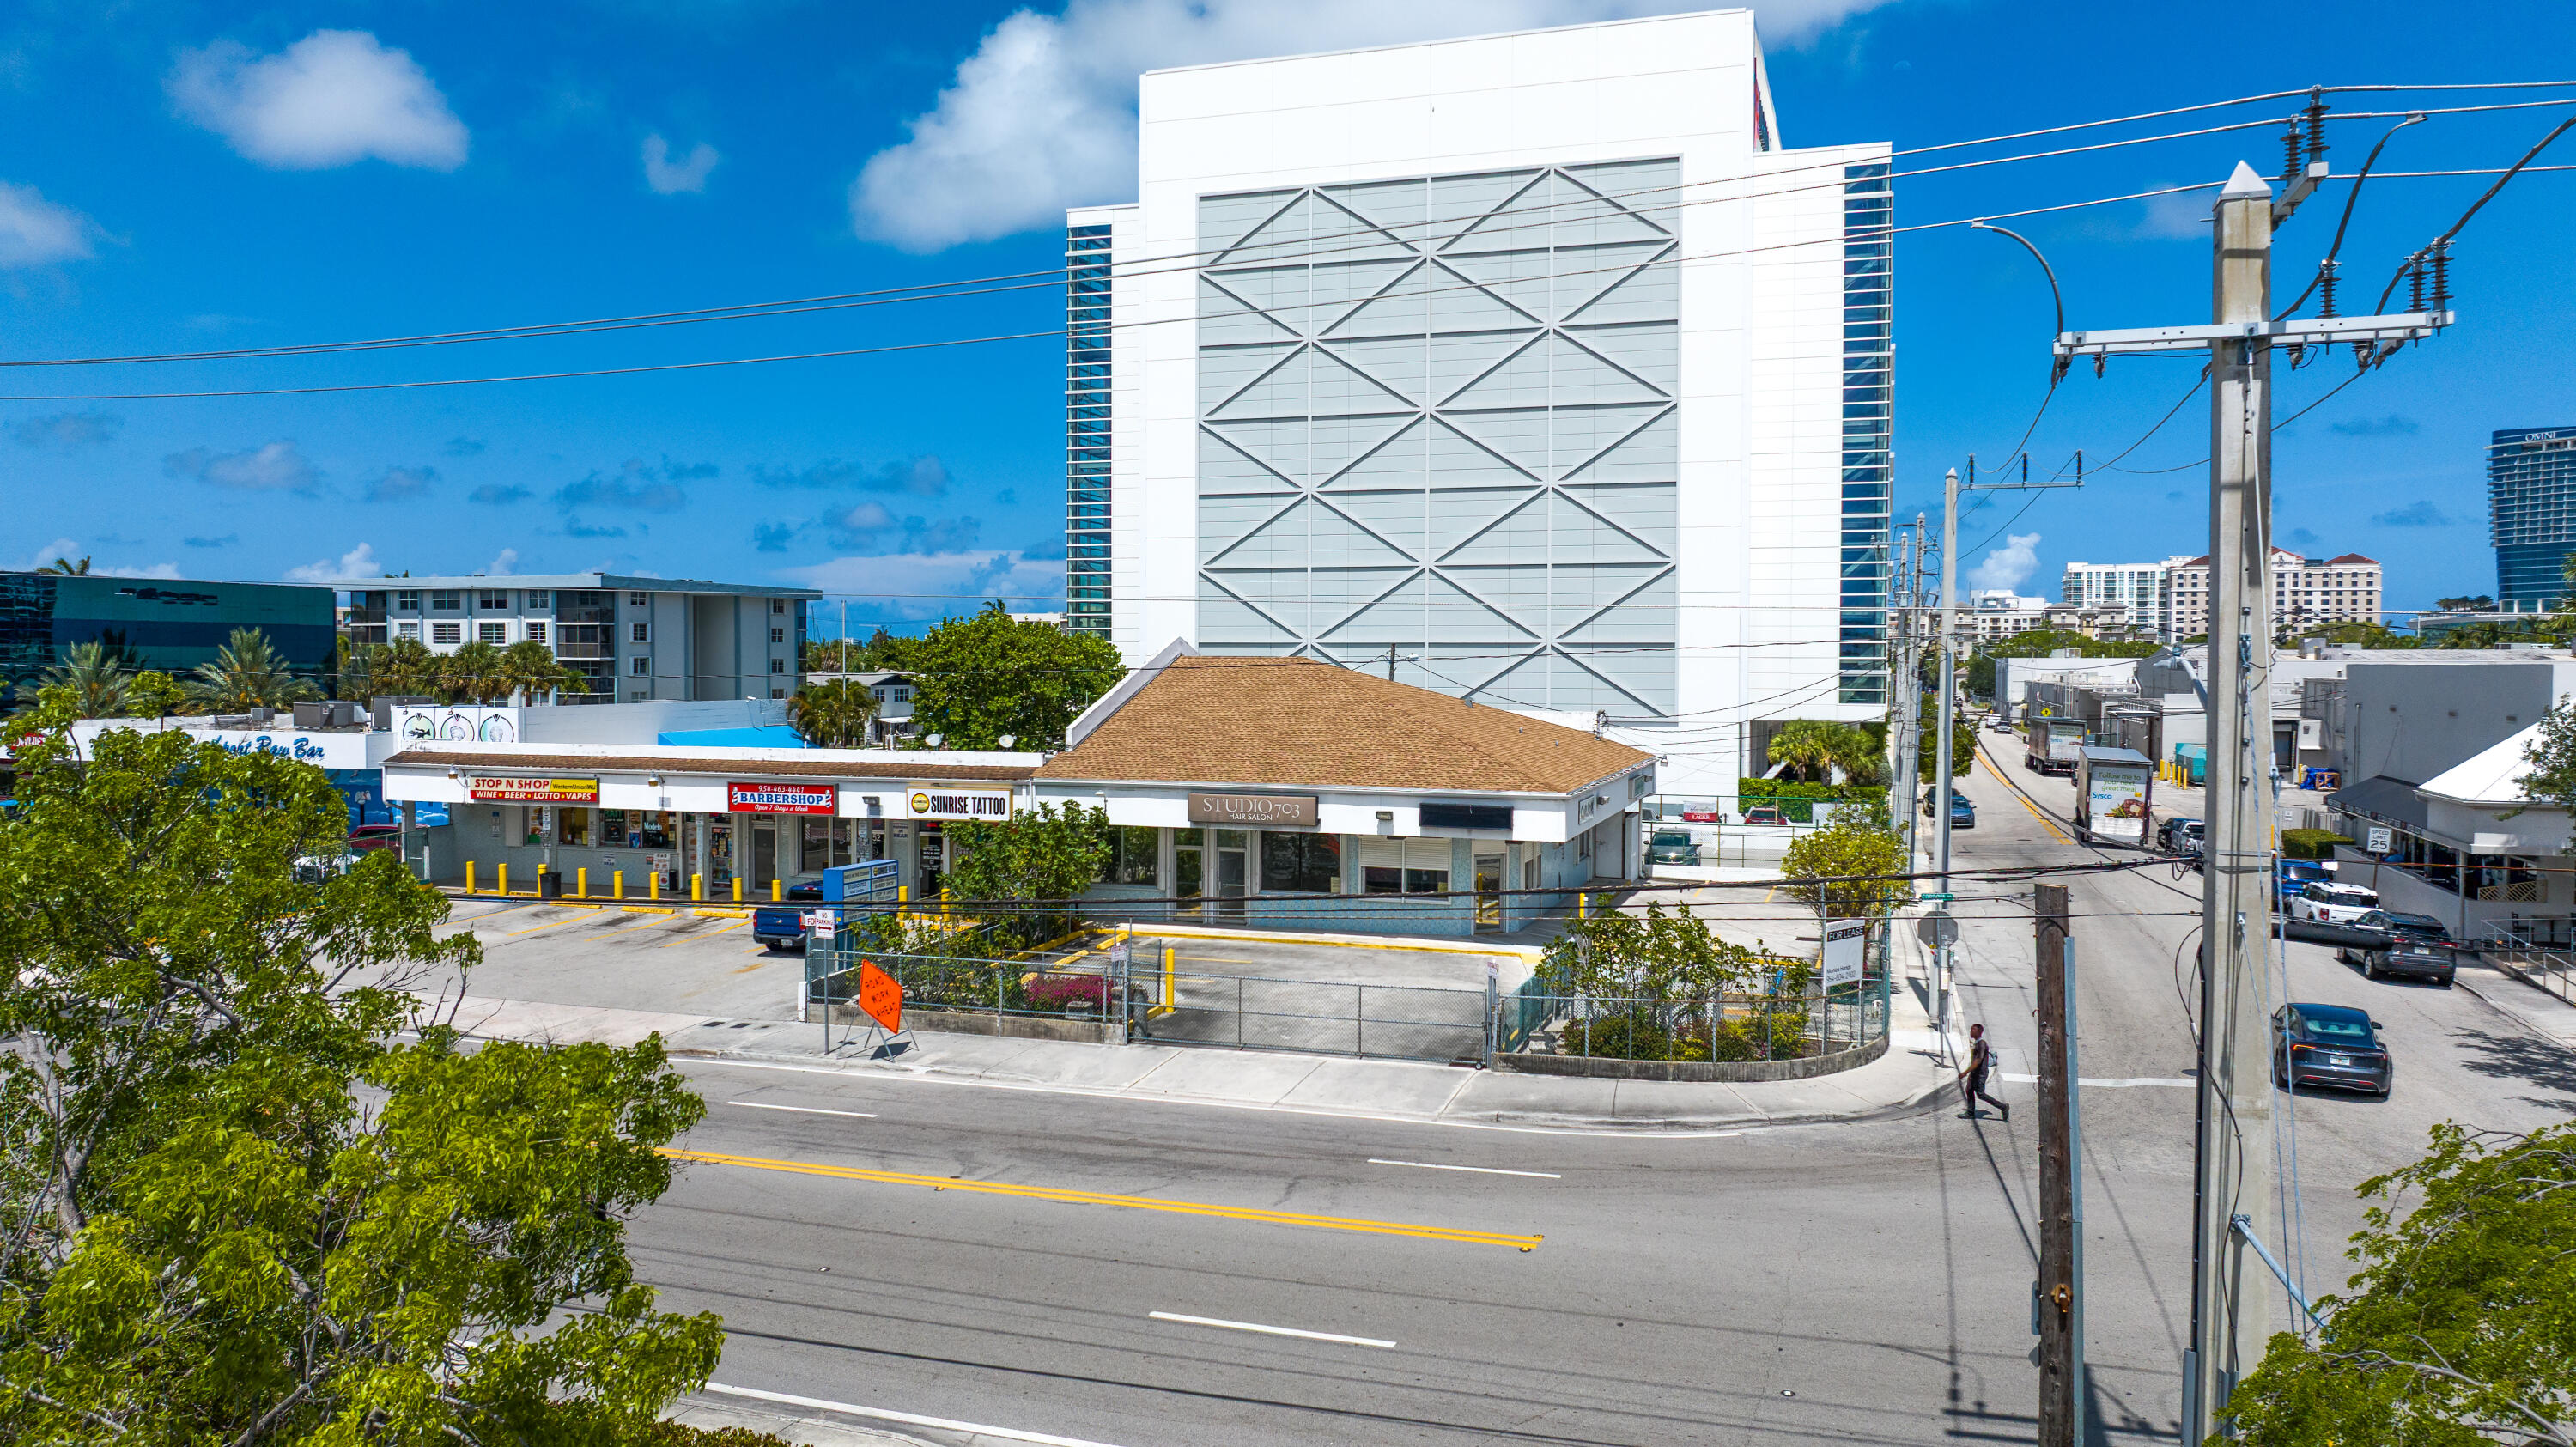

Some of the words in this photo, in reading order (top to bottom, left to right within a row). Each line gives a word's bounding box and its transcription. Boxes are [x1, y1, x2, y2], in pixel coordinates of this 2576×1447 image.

[2525, 431, 2555, 441] OMNI
[256, 735, 289, 757] Raw
[293, 737, 325, 759] Bar
[475, 779, 502, 788] STOP
[506, 779, 514, 788] N
[517, 779, 550, 790] SHOP
[758, 785, 805, 793] 954-463-4441
[476, 790, 497, 799] WINE
[504, 791, 526, 799] BEER
[533, 792, 560, 800] LOTTO
[740, 793, 823, 805] BARBERSHOP
[931, 795, 969, 814] SUNRISE
[971, 796, 1005, 815] TATTOO
[1203, 797, 1273, 814] STUDIO
[1274, 803, 1300, 818] 703
[644, 821, 663, 830] Modelo
[2370, 840, 2387, 850] 25
[807, 917, 817, 926] FO
[1829, 932, 1844, 942] FOR
[1844, 927, 1864, 939] LEASE
[865, 976, 884, 988] ROAD
[872, 989, 890, 1003] WORK
[876, 1002, 898, 1017] AHEAD
